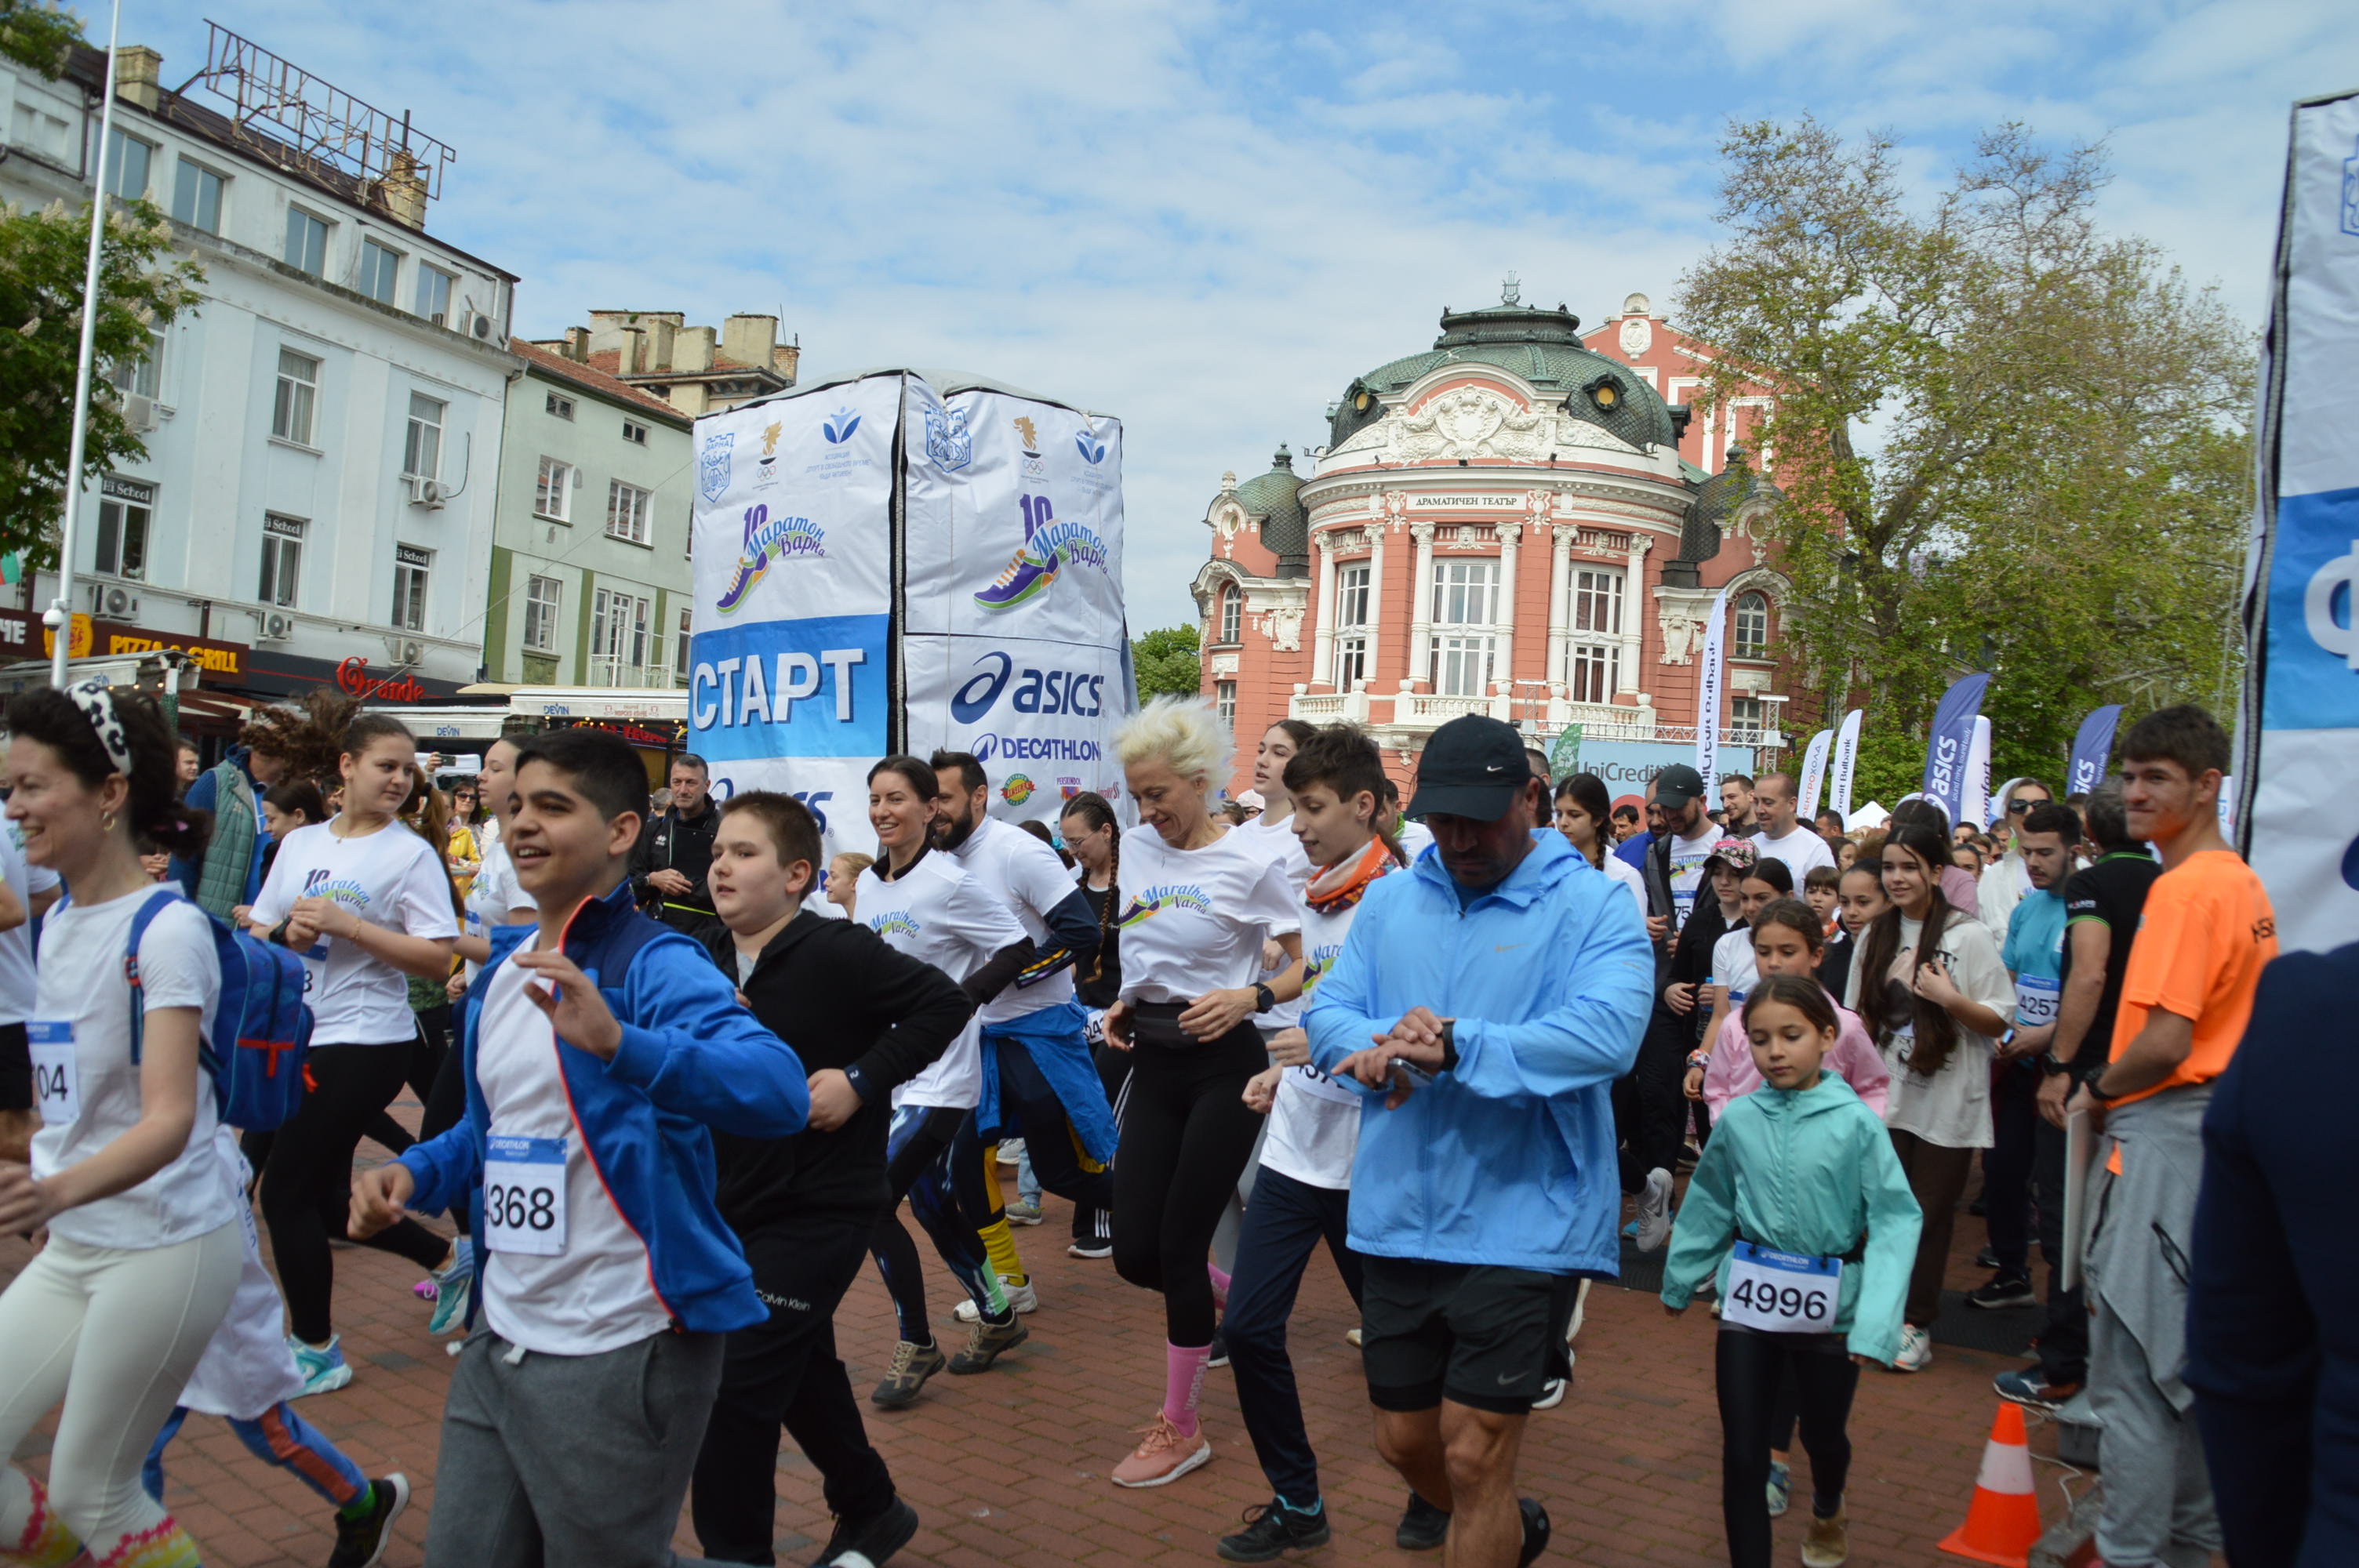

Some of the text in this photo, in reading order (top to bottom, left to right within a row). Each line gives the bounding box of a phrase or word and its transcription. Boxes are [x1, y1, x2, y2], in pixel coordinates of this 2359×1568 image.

[103, 481, 150, 501] Hi School
[1416, 497, 1517, 506] ДРАМАТИЧЕН ТЕАТЪР
[273, 519, 300, 535] School
[744, 504, 768, 552] 10
[1020, 493, 1053, 546] 10
[747, 517, 825, 558] Маратон
[778, 534, 825, 557] Варна
[1033, 522, 1107, 564] Маратон
[403, 550, 427, 564] School
[1067, 539, 1108, 574] Варна
[110, 635, 162, 655] PIZZA
[188, 646, 238, 673] GRILL
[336, 657, 424, 702] Grande
[692, 648, 867, 731] СТАРТ
[543, 704, 569, 715] DEVIN
[437, 727, 460, 736] DEVIN
[1001, 737, 1101, 761] DECATHLON
[1840, 739, 1852, 782] Bulbank
[1056, 776, 1081, 785] PERSKINDOL
[1802, 745, 1822, 818] ЛЕКТРОХОЛД
[2074, 758, 2095, 794] ics
[307, 880, 371, 904] Marathon
[334, 890, 365, 911] Varna
[1143, 884, 1211, 906] Marathon
[1171, 895, 1208, 914] Varna
[1674, 906, 1692, 921] 75
[871, 910, 921, 932] Marathon
[890, 922, 917, 938] Varna
[1312, 943, 1343, 964] Mara
[32, 1063, 68, 1102] 04
[754, 1289, 811, 1312] Calvin Klein
[1732, 1279, 1828, 1320] 4996
